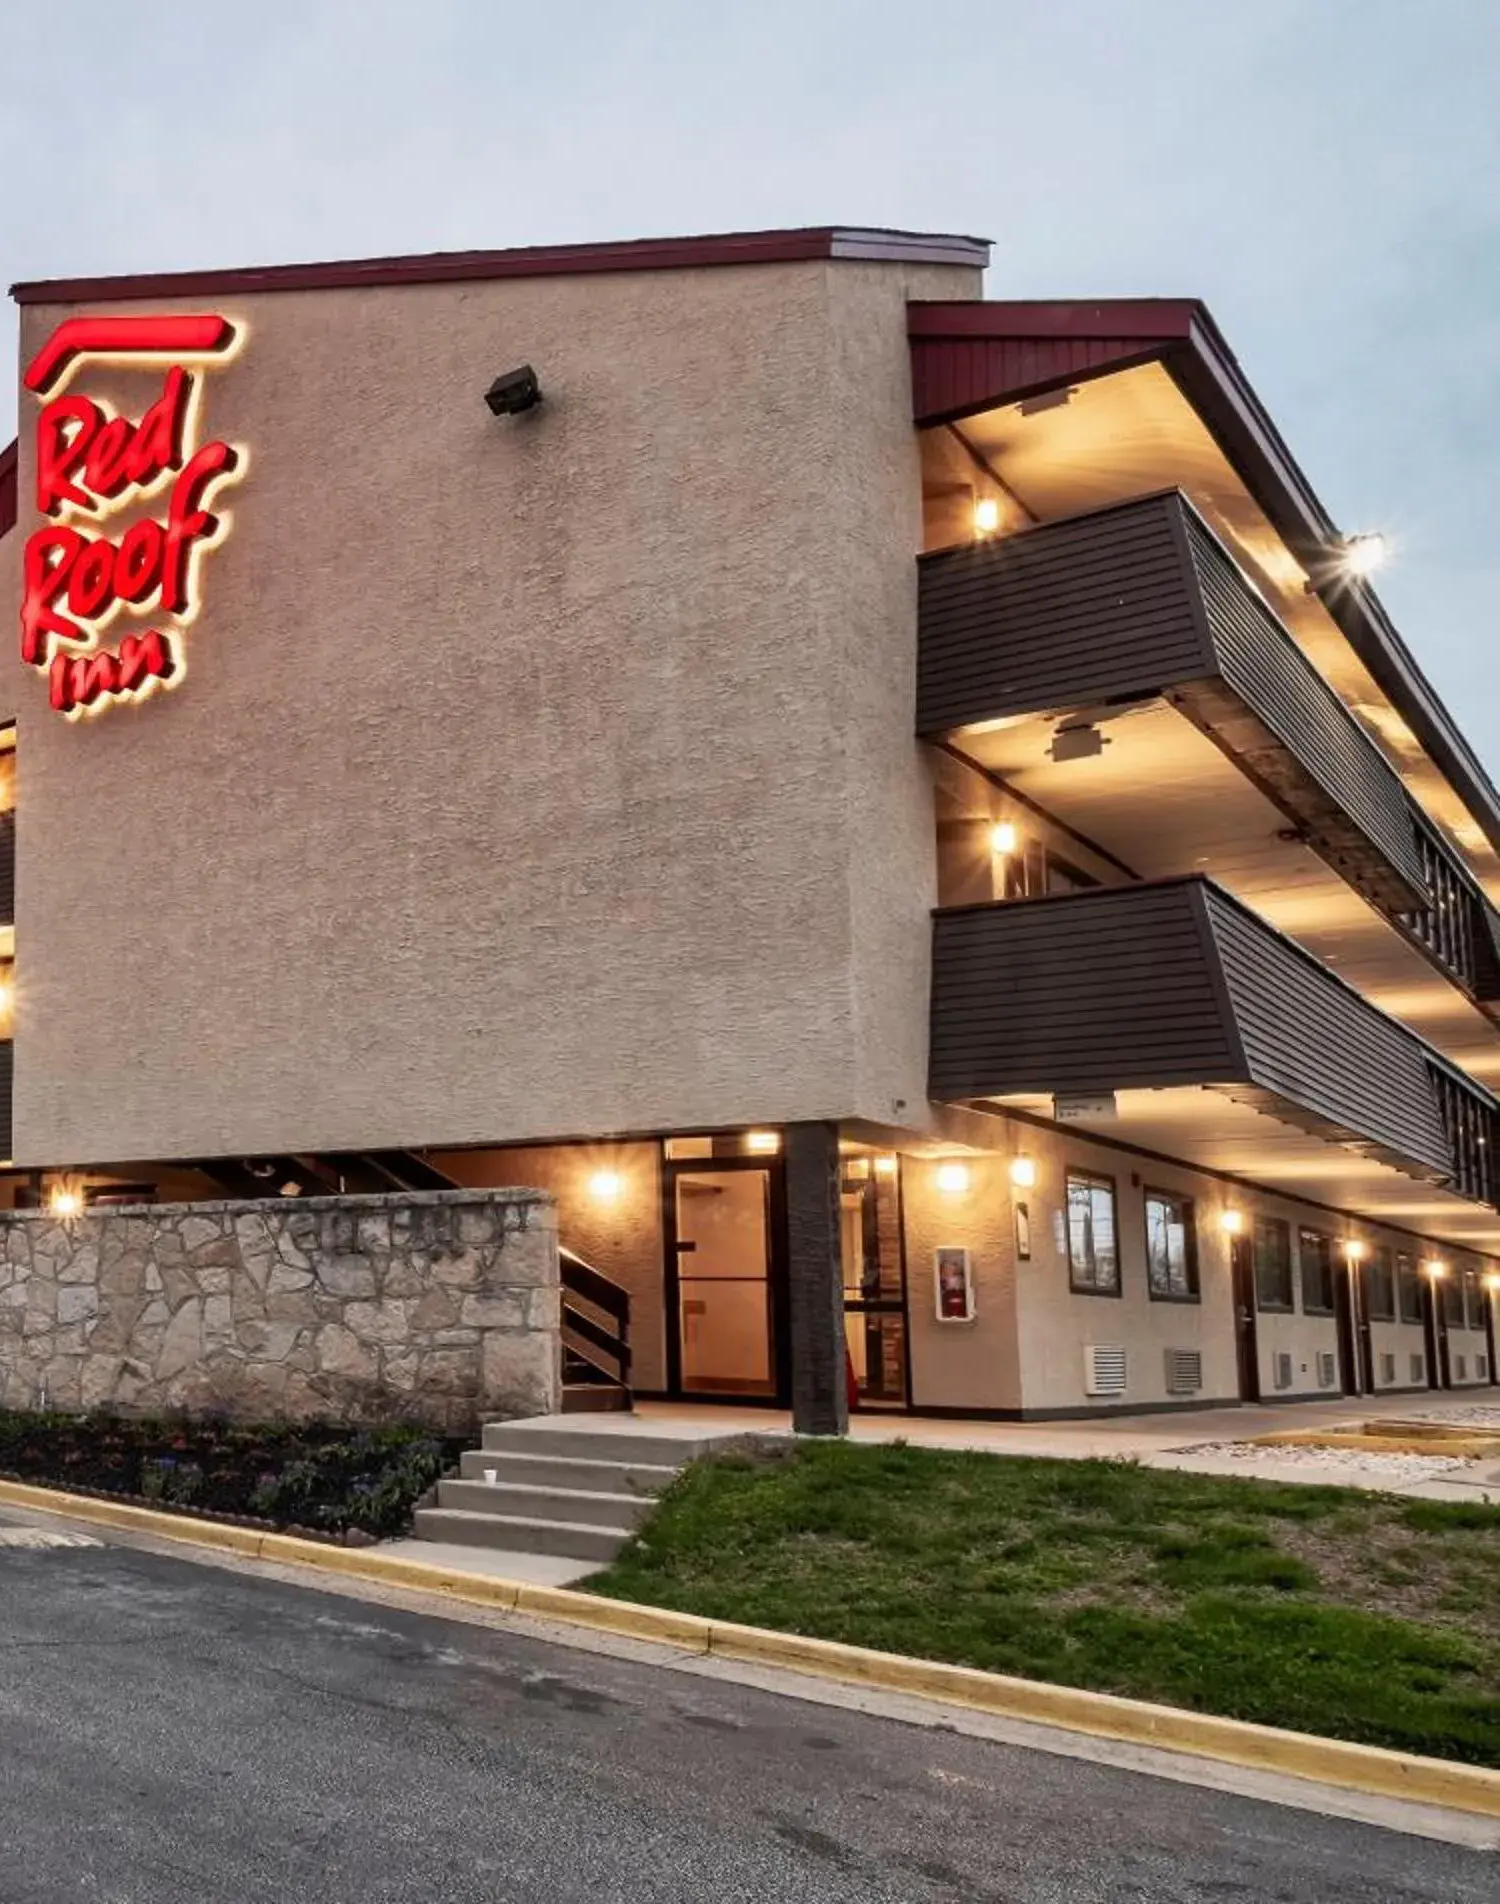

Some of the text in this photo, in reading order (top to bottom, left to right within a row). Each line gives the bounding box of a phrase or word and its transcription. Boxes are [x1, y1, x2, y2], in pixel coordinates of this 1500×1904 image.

[37, 365, 192, 516] Red
[21, 441, 238, 665] Roof
[49, 629, 176, 711] Inn
